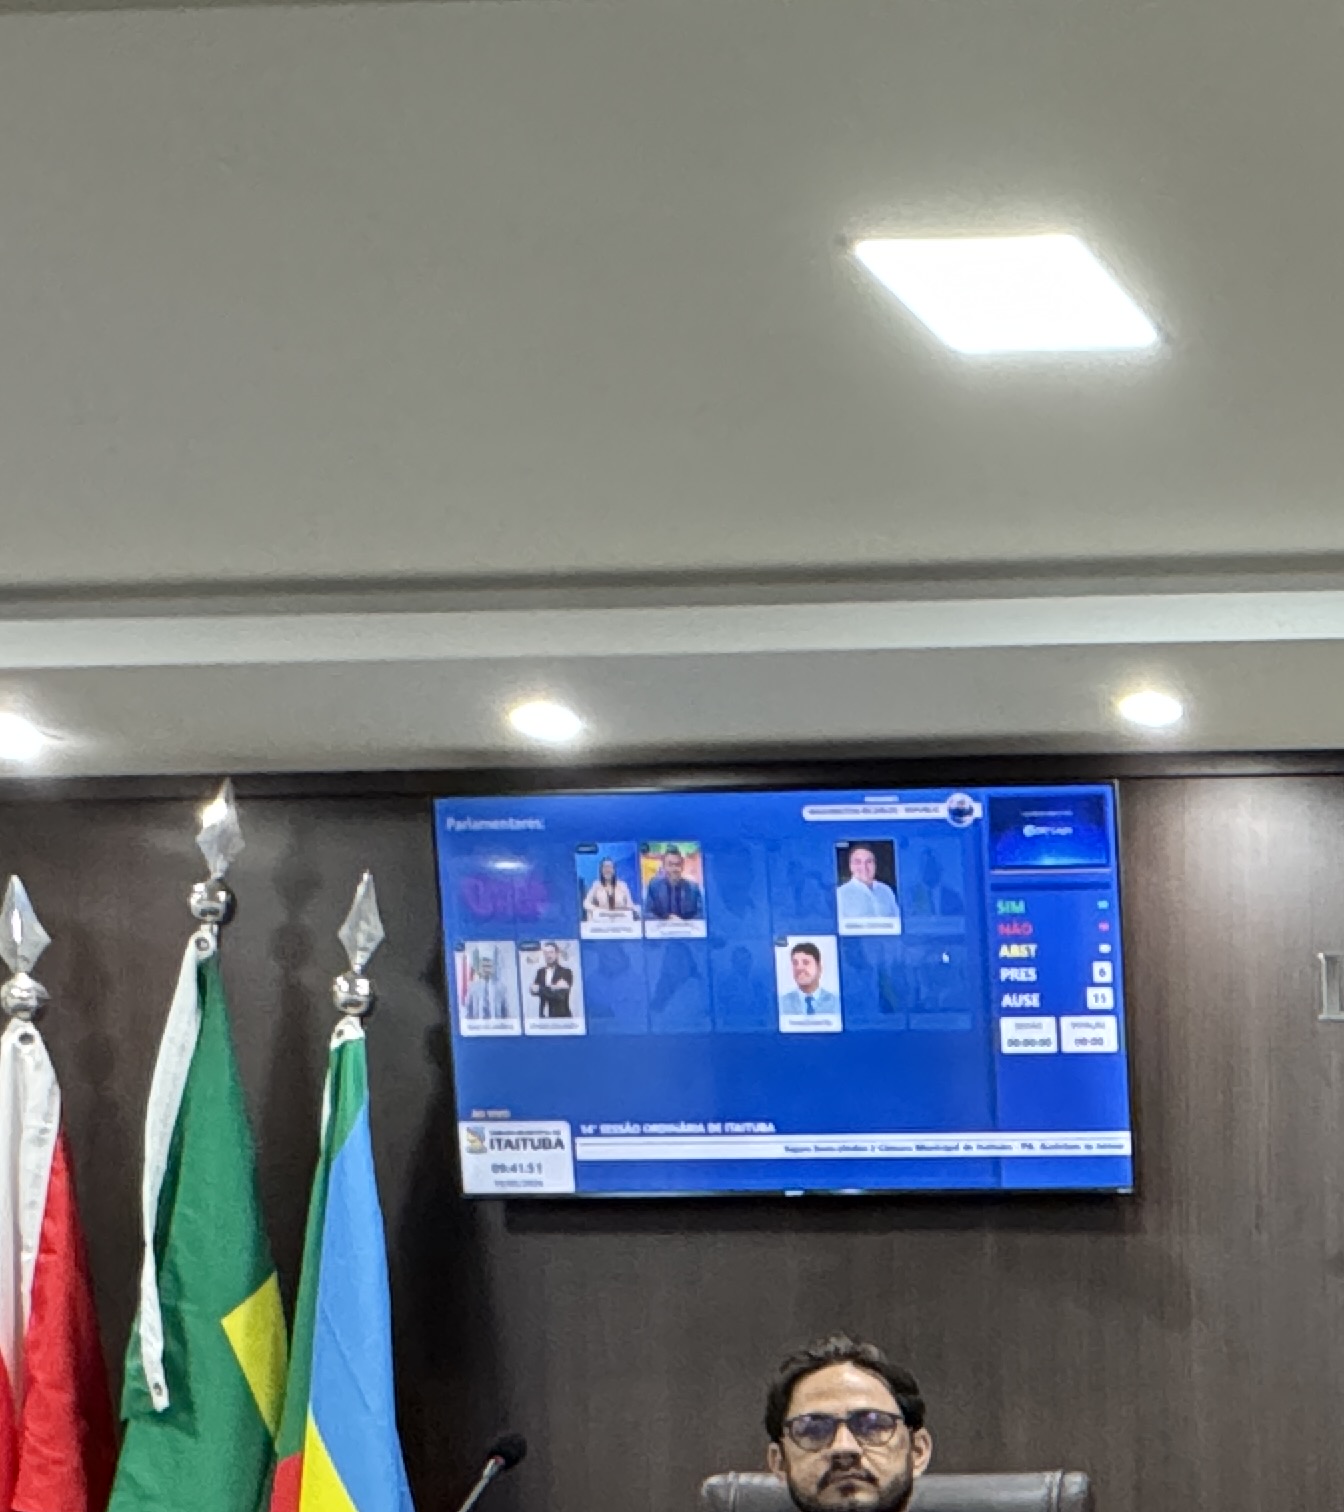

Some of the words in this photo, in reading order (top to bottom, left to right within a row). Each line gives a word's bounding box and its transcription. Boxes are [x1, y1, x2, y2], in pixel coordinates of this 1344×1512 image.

[999, 943, 1038, 958] ABST
[1000, 967, 1037, 982] PRES
[1001, 993, 1041, 1008] AUSE
[489, 1136, 566, 1151] ITAITUBA
